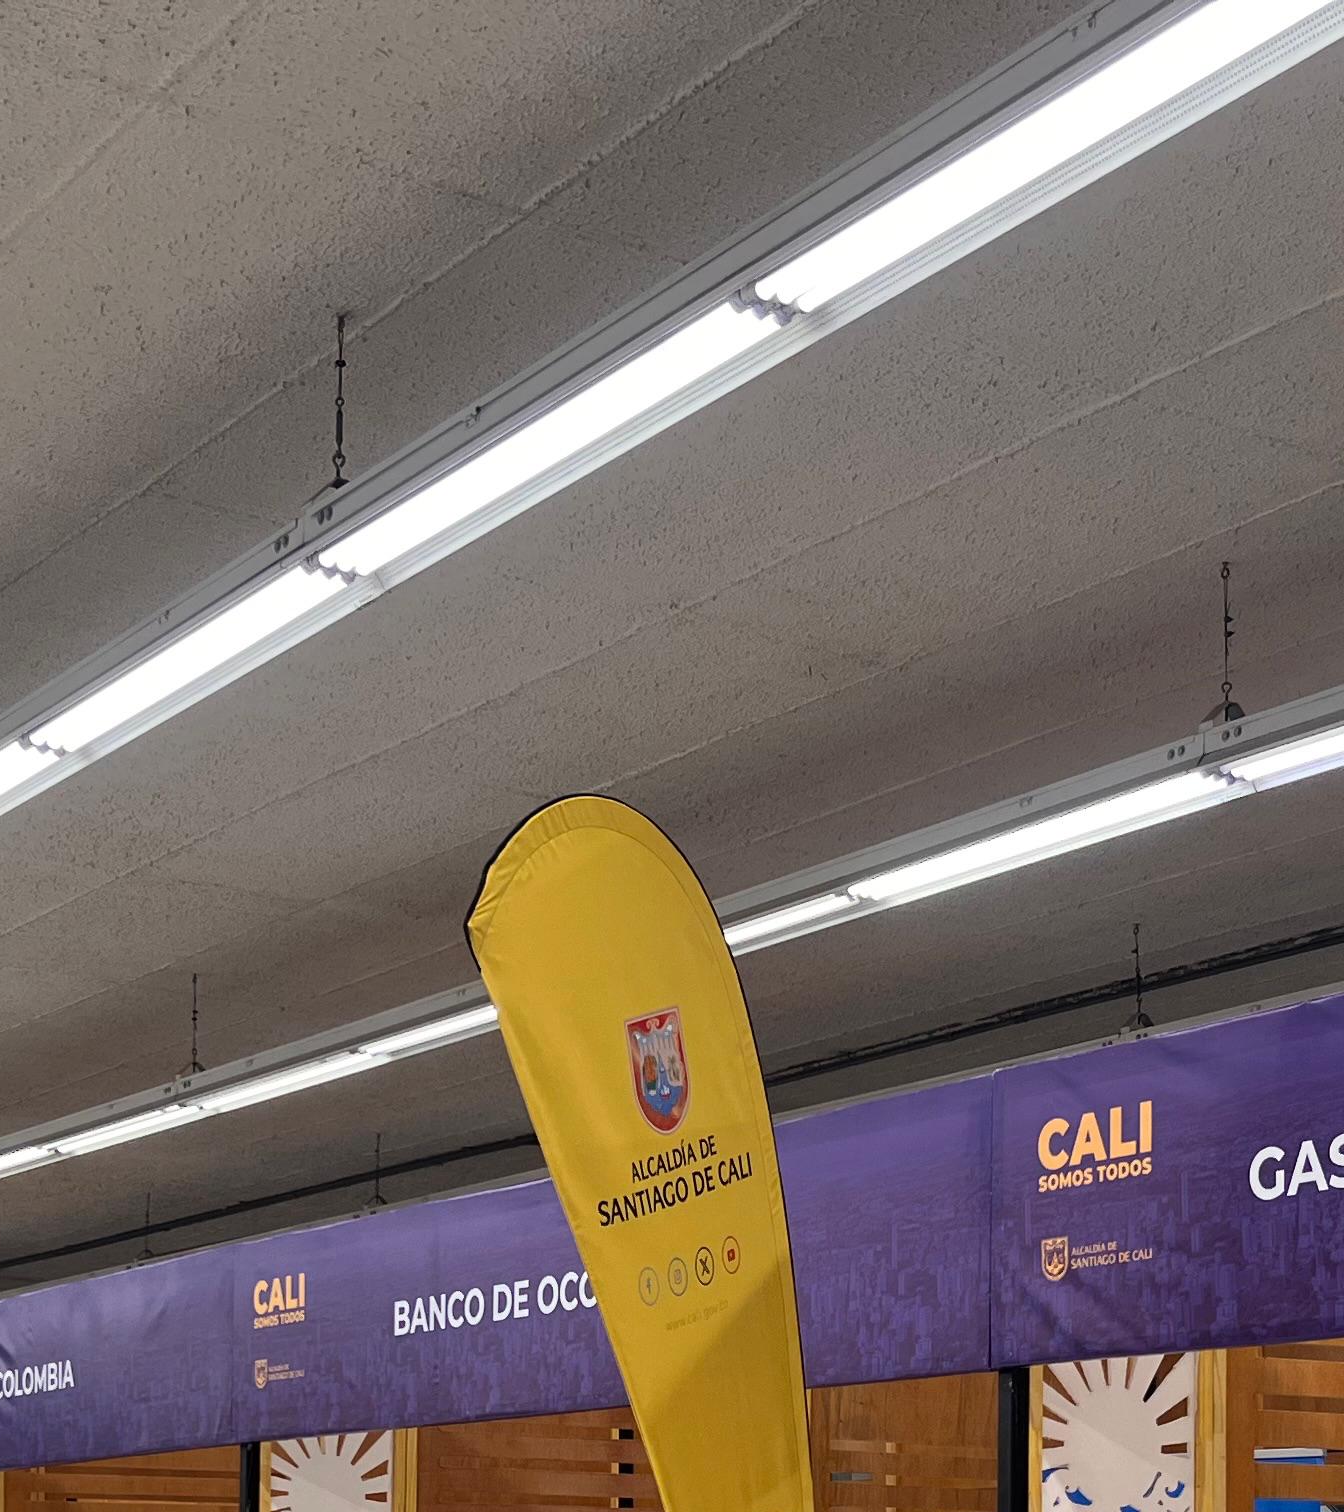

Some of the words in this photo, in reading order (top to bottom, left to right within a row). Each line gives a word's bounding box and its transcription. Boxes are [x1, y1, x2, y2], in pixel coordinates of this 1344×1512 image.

[1037, 1100, 1153, 1171] CALI
[631, 1138, 697, 1184] ALCALDÍA
[699, 1135, 718, 1158] DE
[1038, 1167, 1093, 1193] SOMOS
[1096, 1157, 1153, 1183] TODOS
[597, 1176, 689, 1227] SANTIAGO
[692, 1166, 716, 1197] DE
[718, 1152, 753, 1187] CALI
[1070, 1253, 1116, 1270] SANTIAGO
[1118, 1251, 1130, 1263] DE
[1132, 1247, 1154, 1261] CALI
[1107, 1240, 1118, 1251] DE
[253, 1272, 306, 1315] CALI
[393, 1287, 484, 1337] BANCO
[492, 1279, 530, 1323] DE
[536, 1271, 599, 1316] OCC
